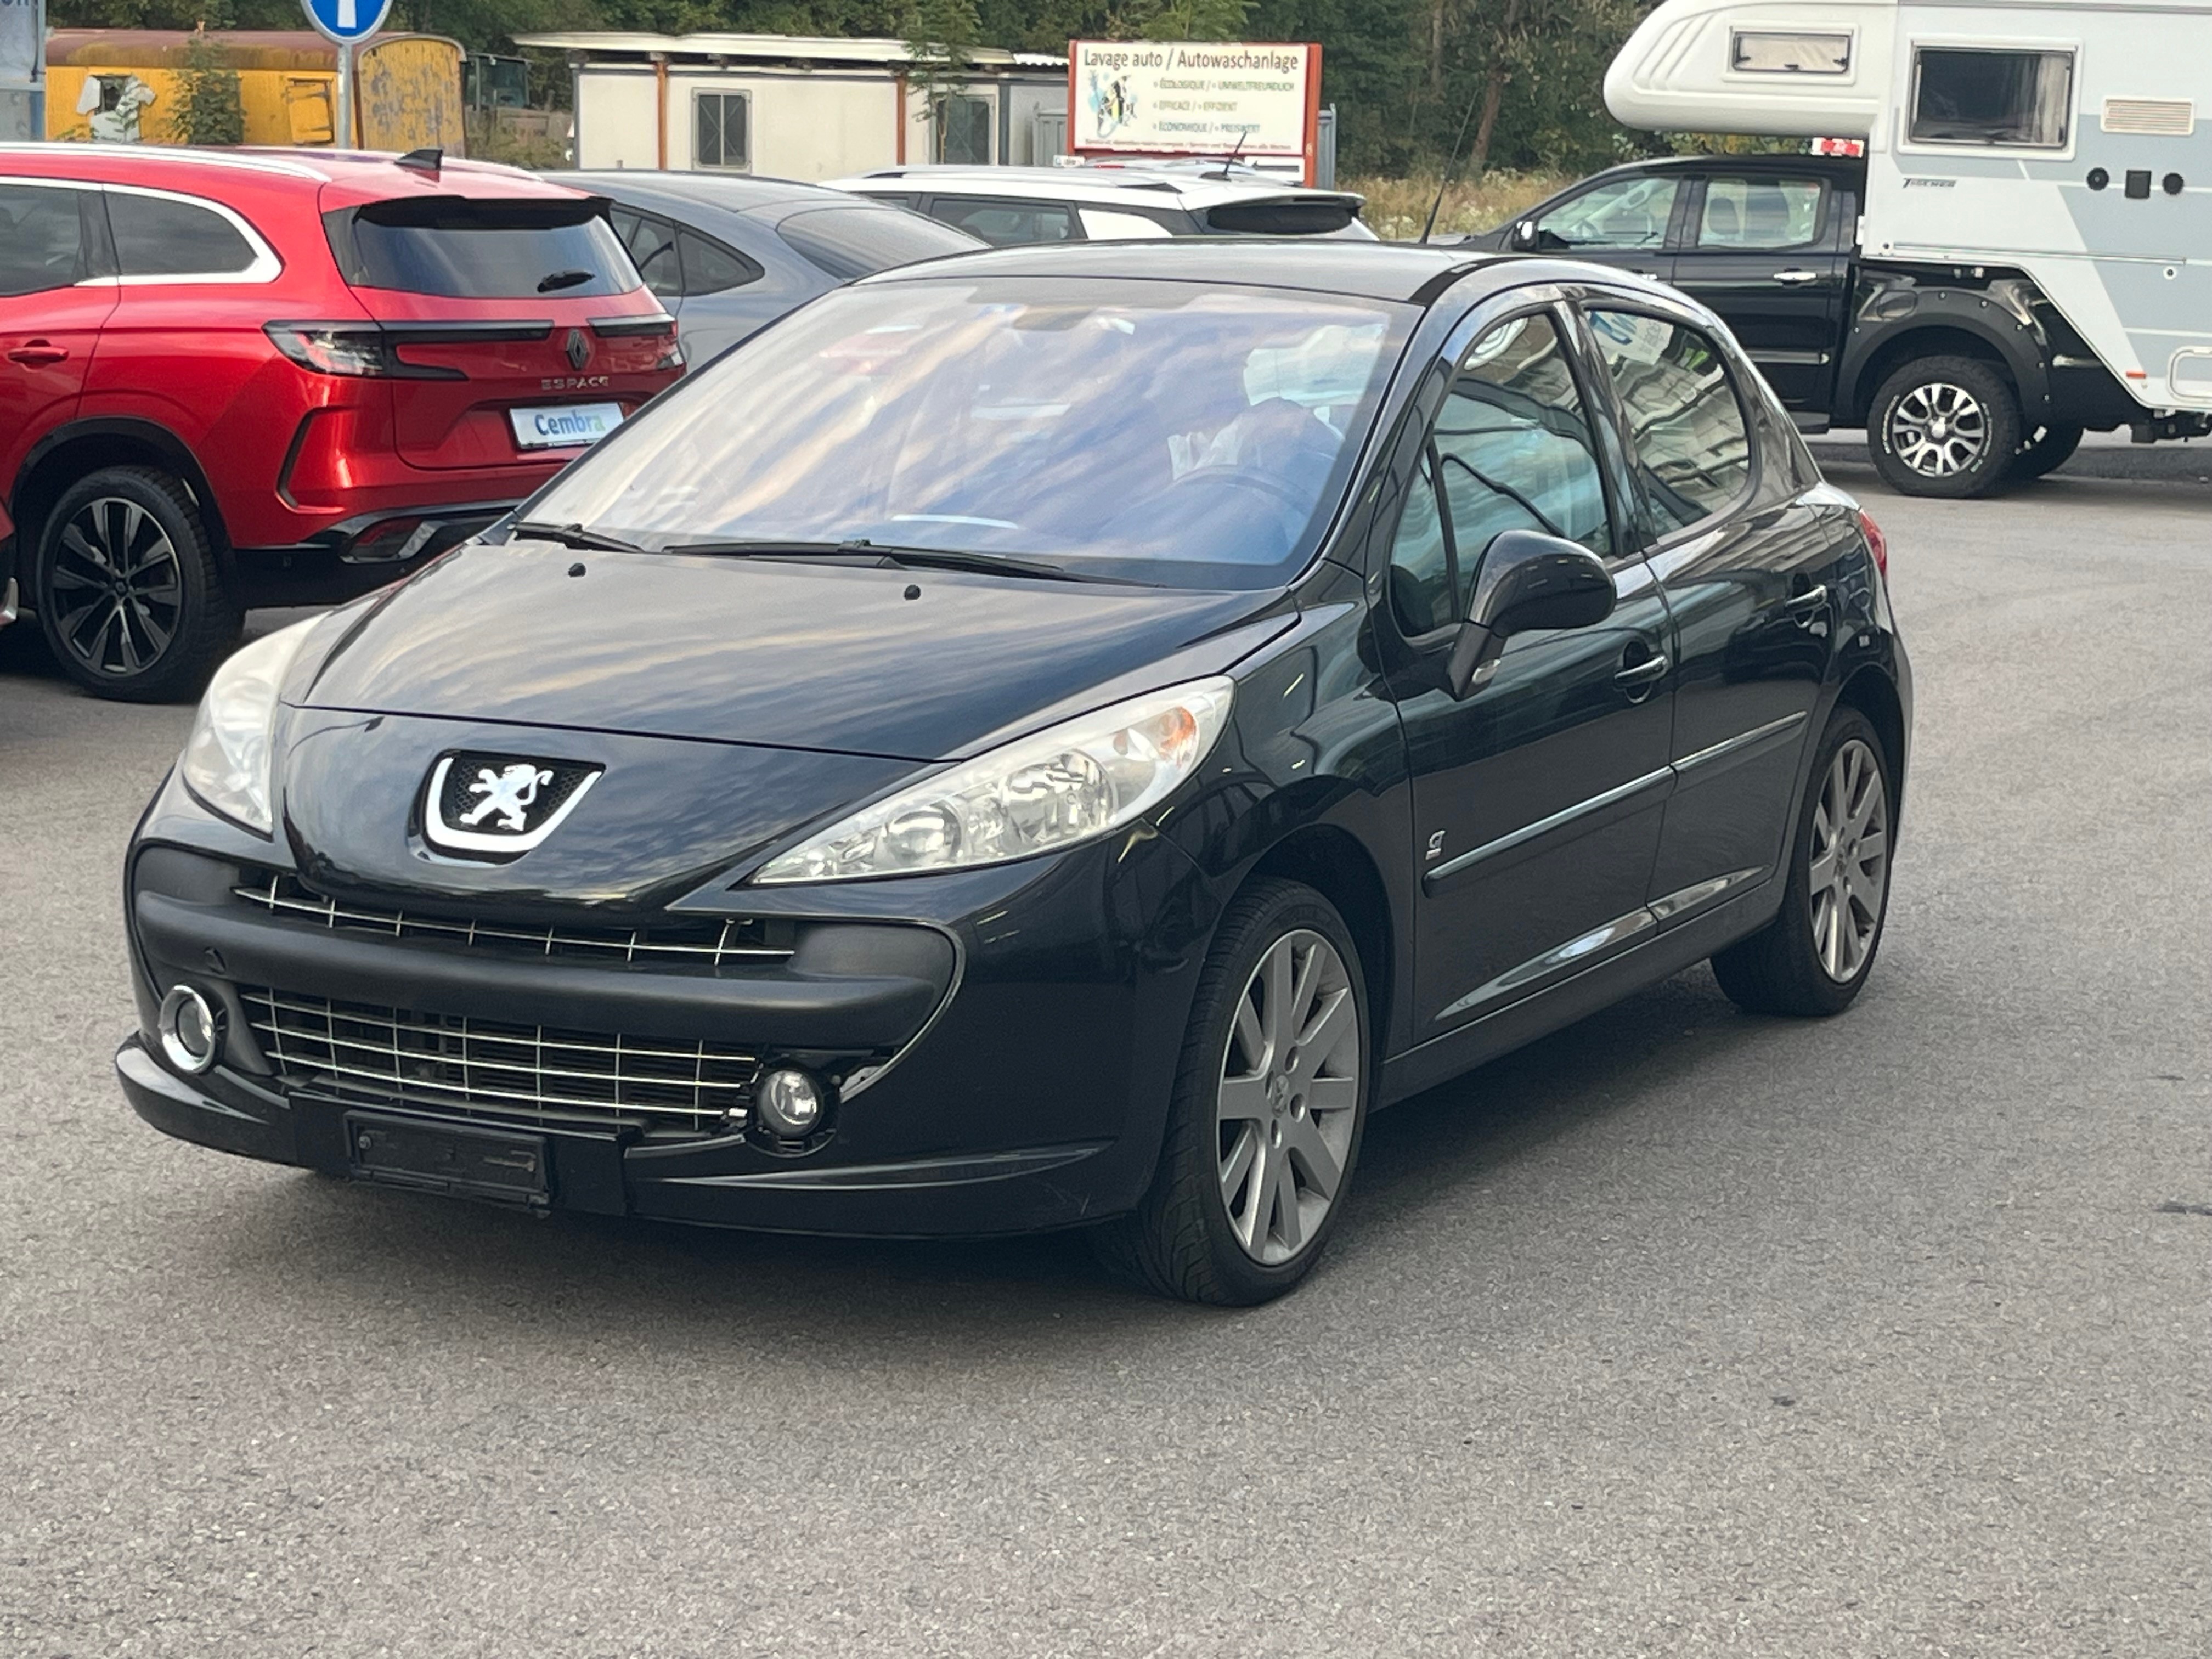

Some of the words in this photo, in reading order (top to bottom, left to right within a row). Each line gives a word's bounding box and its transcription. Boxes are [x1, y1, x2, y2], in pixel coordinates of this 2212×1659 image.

[1084, 48, 1128, 71] Lavage
[1132, 52, 1163, 67] auto
[1165, 47, 1175, 71] /
[1177, 49, 1299, 74] Autowaschanlage
[541, 376, 609, 390] ESPACE
[534, 410, 606, 436] Cembra
